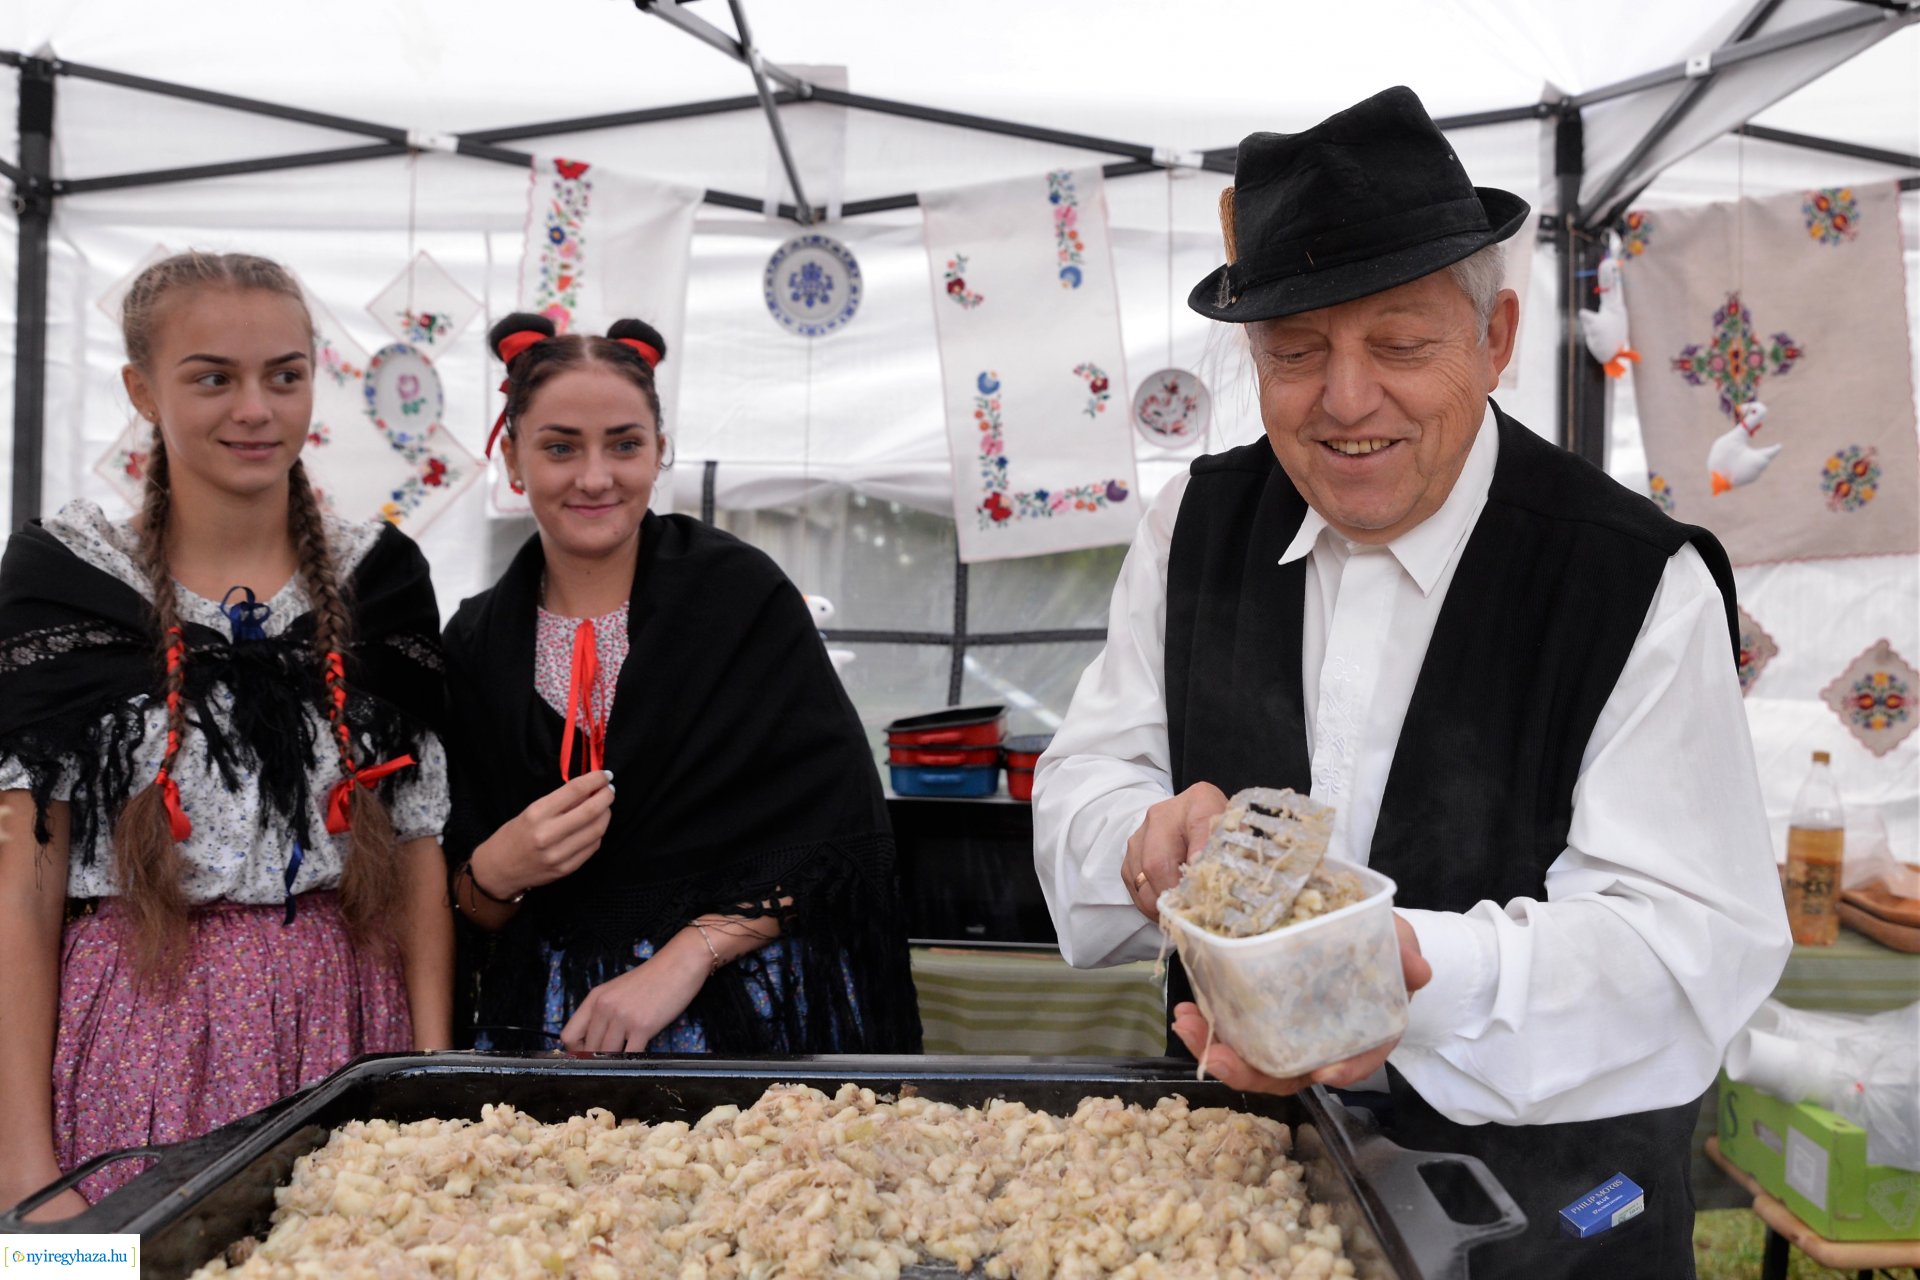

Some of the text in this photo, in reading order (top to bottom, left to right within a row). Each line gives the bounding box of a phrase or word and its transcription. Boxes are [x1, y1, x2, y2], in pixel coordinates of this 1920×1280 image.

[1571, 1196, 1595, 1214] PHILIP
[1595, 1179, 1623, 1197] MORRIS
[1596, 1195, 1610, 1205] BLUE
